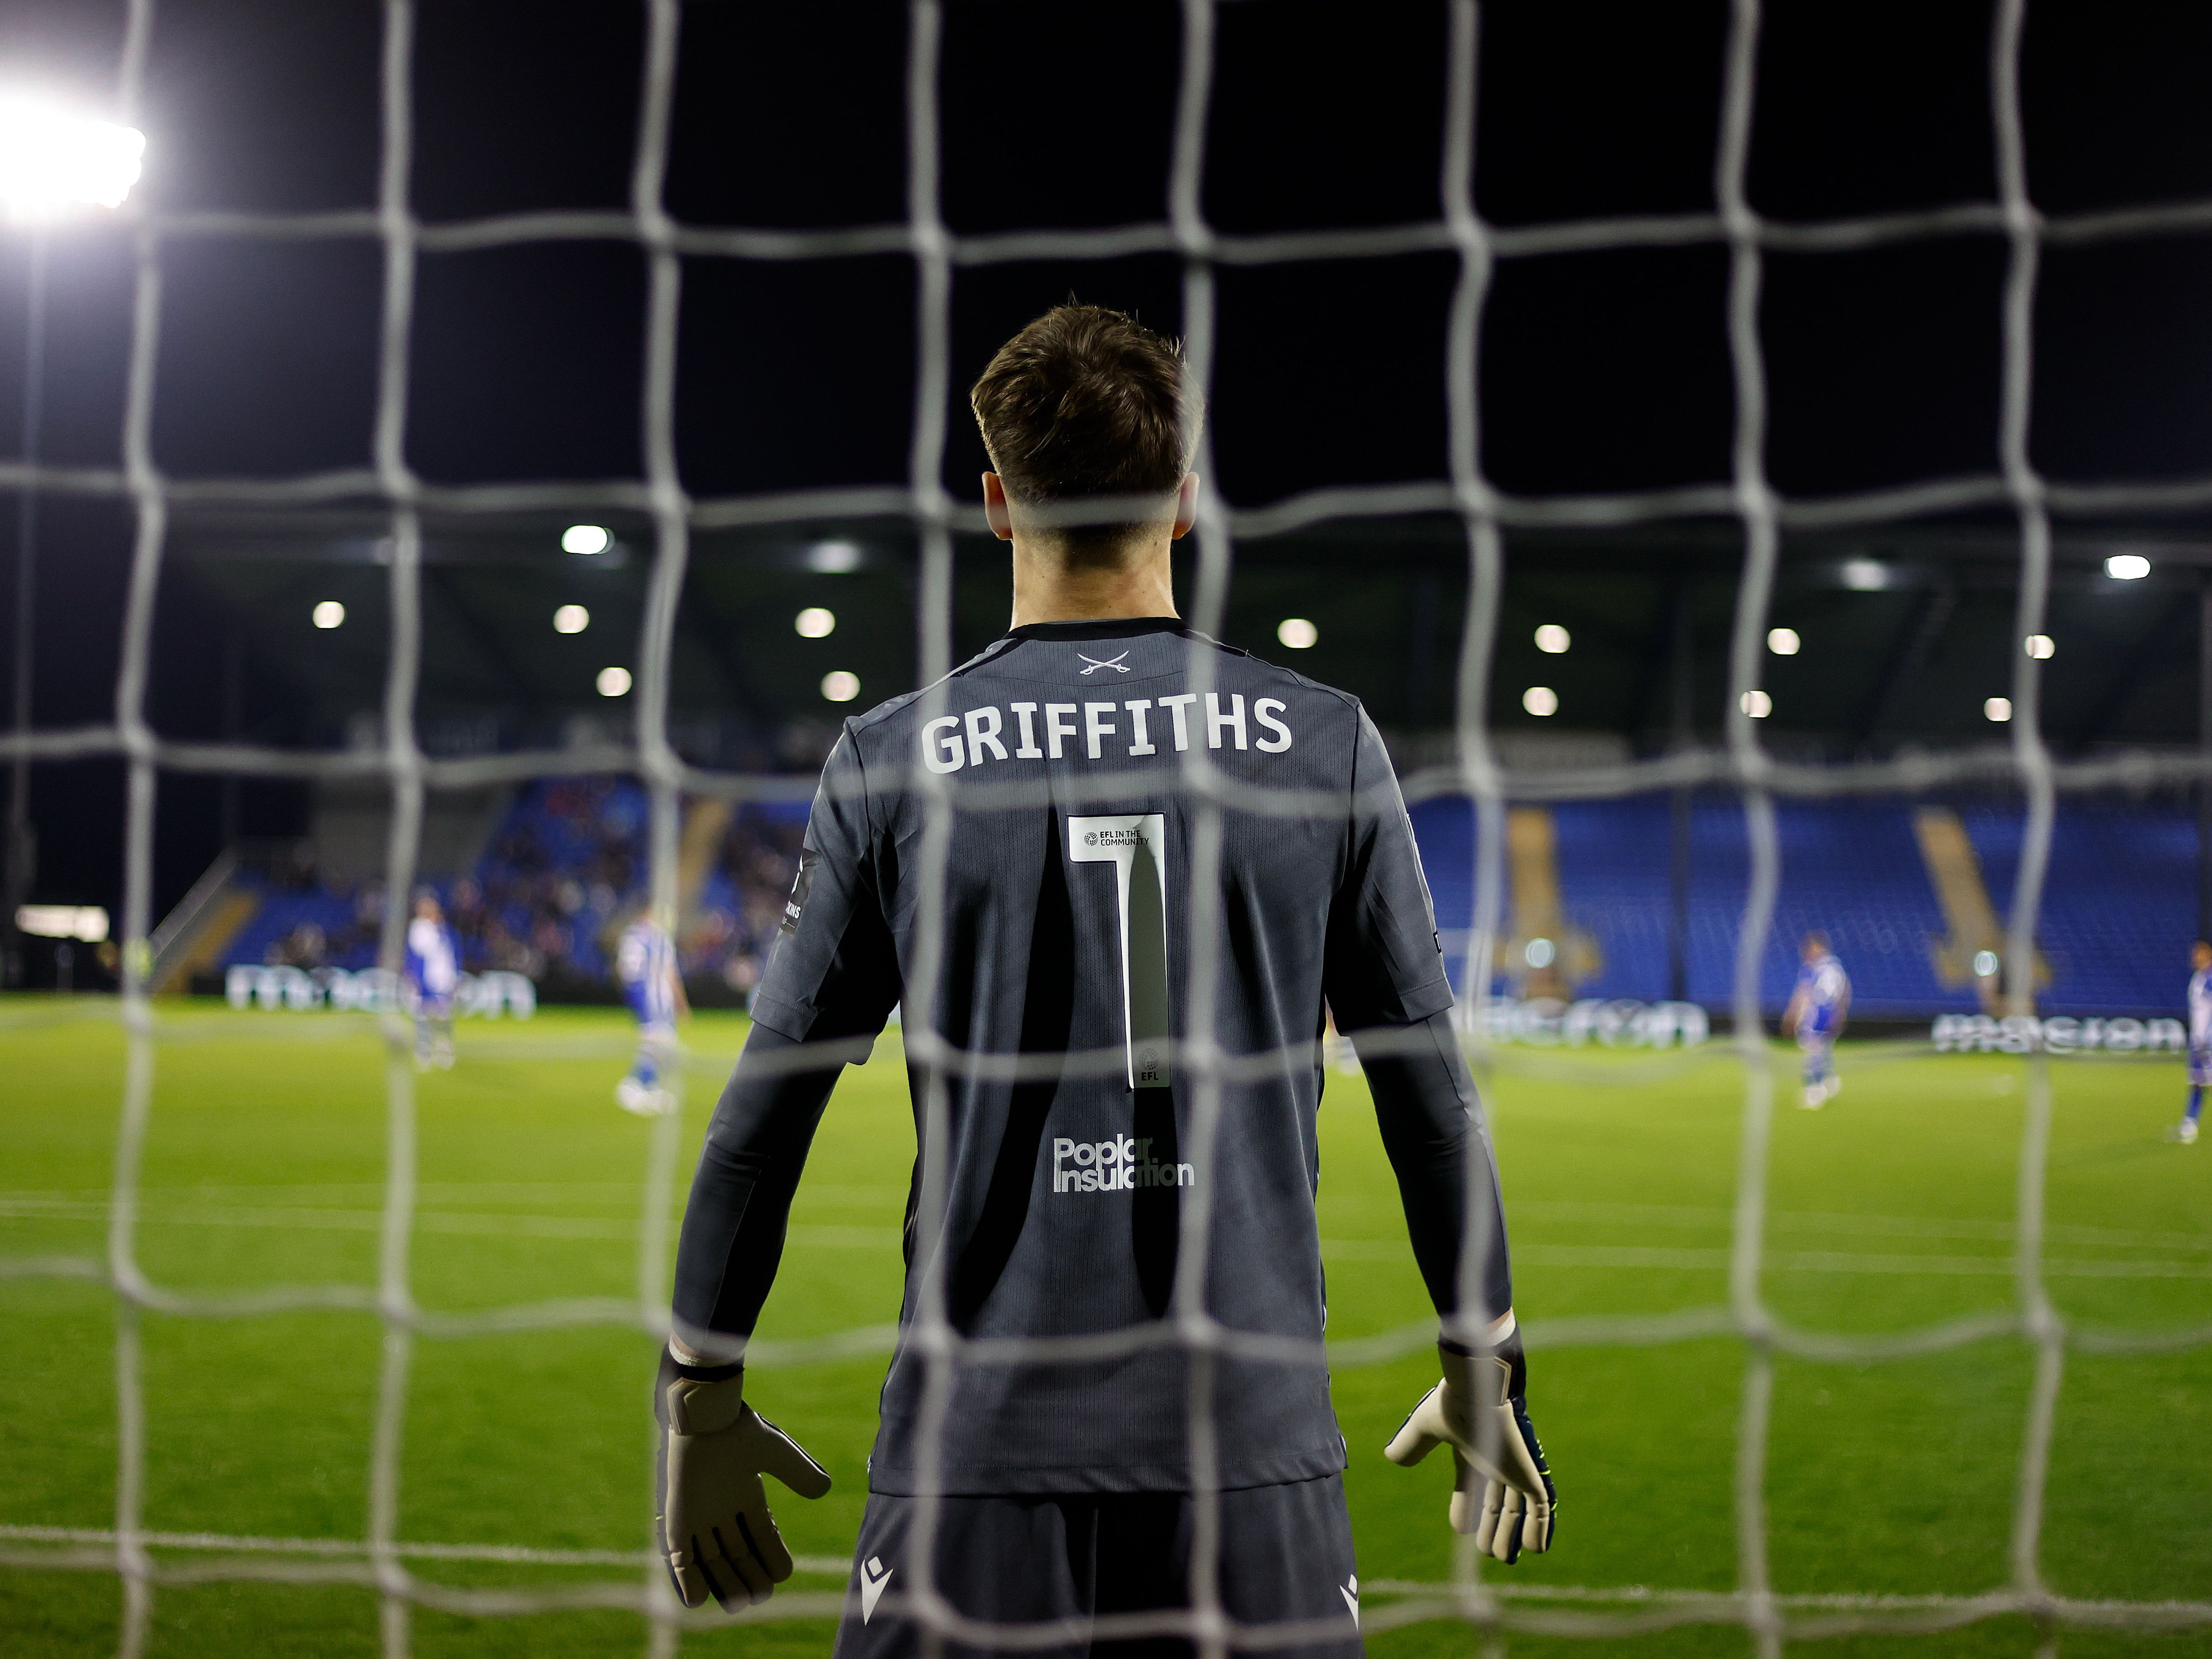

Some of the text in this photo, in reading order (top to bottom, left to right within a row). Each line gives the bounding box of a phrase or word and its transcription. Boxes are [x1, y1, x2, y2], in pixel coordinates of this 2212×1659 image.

[921, 693, 1292, 775] GRIFFITHS
[1101, 838, 1149, 846] COMMUNITY
[1068, 814, 1171, 1089] 1
[1931, 1013, 2187, 1054] macron
[1141, 1072, 1159, 1081] EFL
[1053, 1133, 1153, 1171] Poplar
[1053, 1157, 1195, 1193] Insulation
